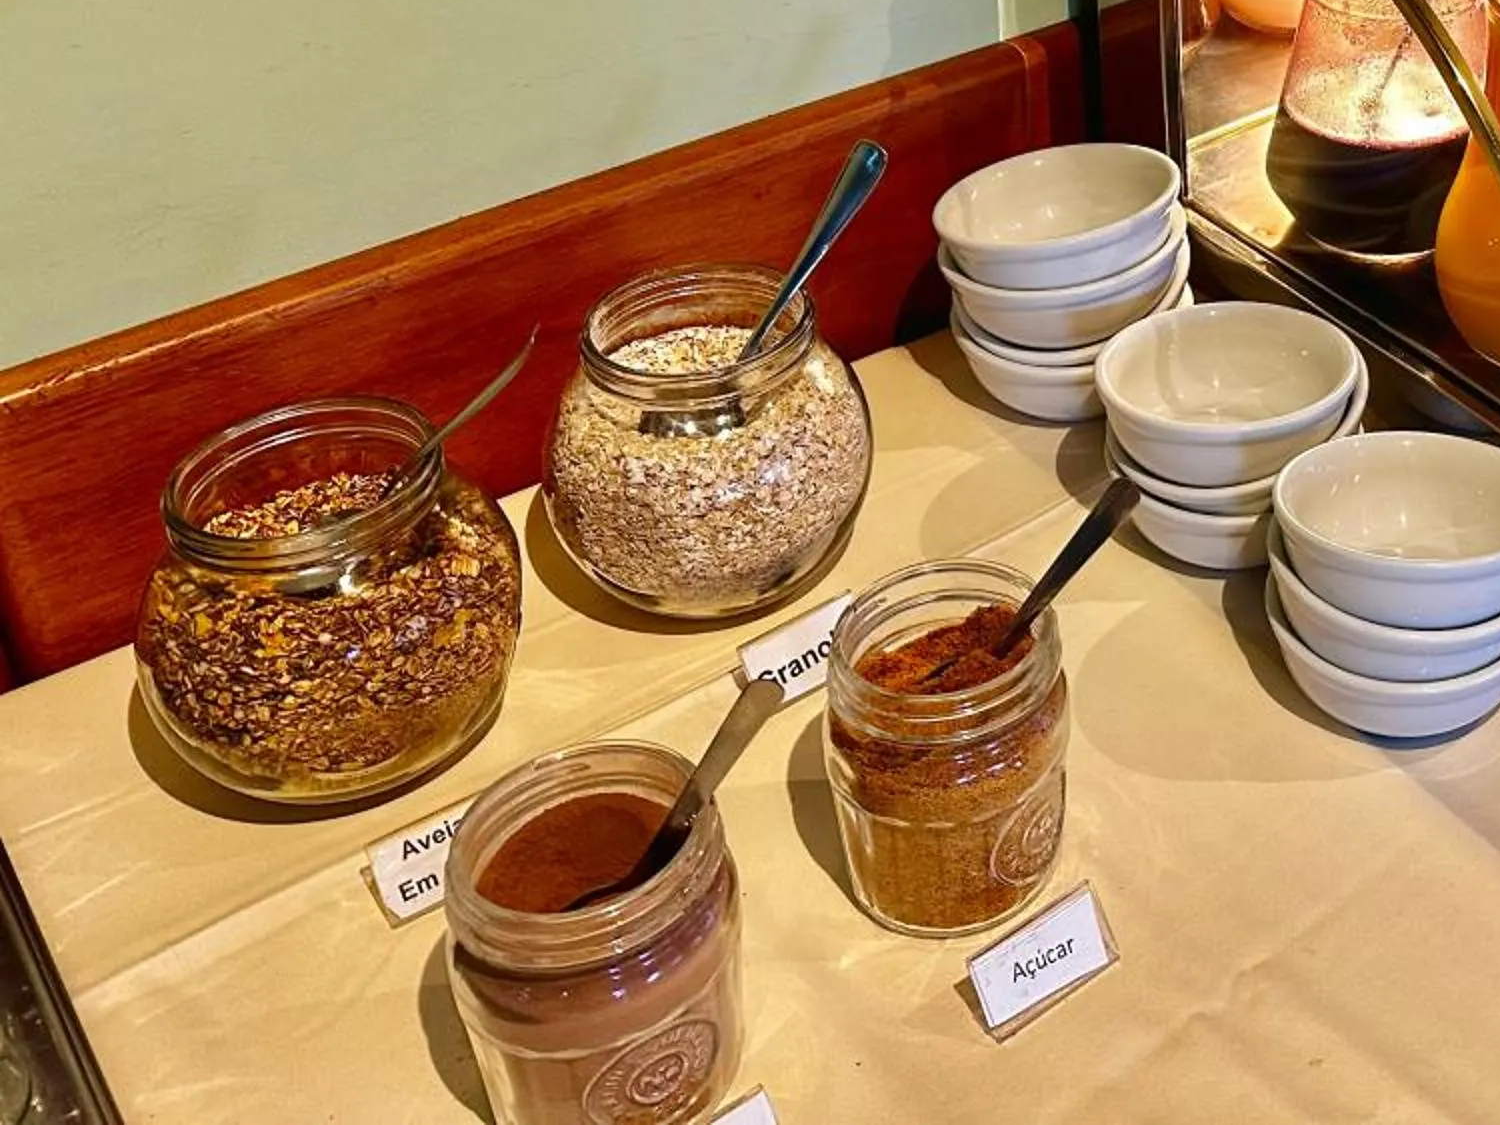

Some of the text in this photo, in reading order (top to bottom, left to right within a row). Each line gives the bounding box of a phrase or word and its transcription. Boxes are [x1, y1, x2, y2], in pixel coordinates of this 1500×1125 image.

[758, 630, 834, 684] rano
[398, 873, 439, 902] Em
[1012, 938, 1075, 983] Açúcar
